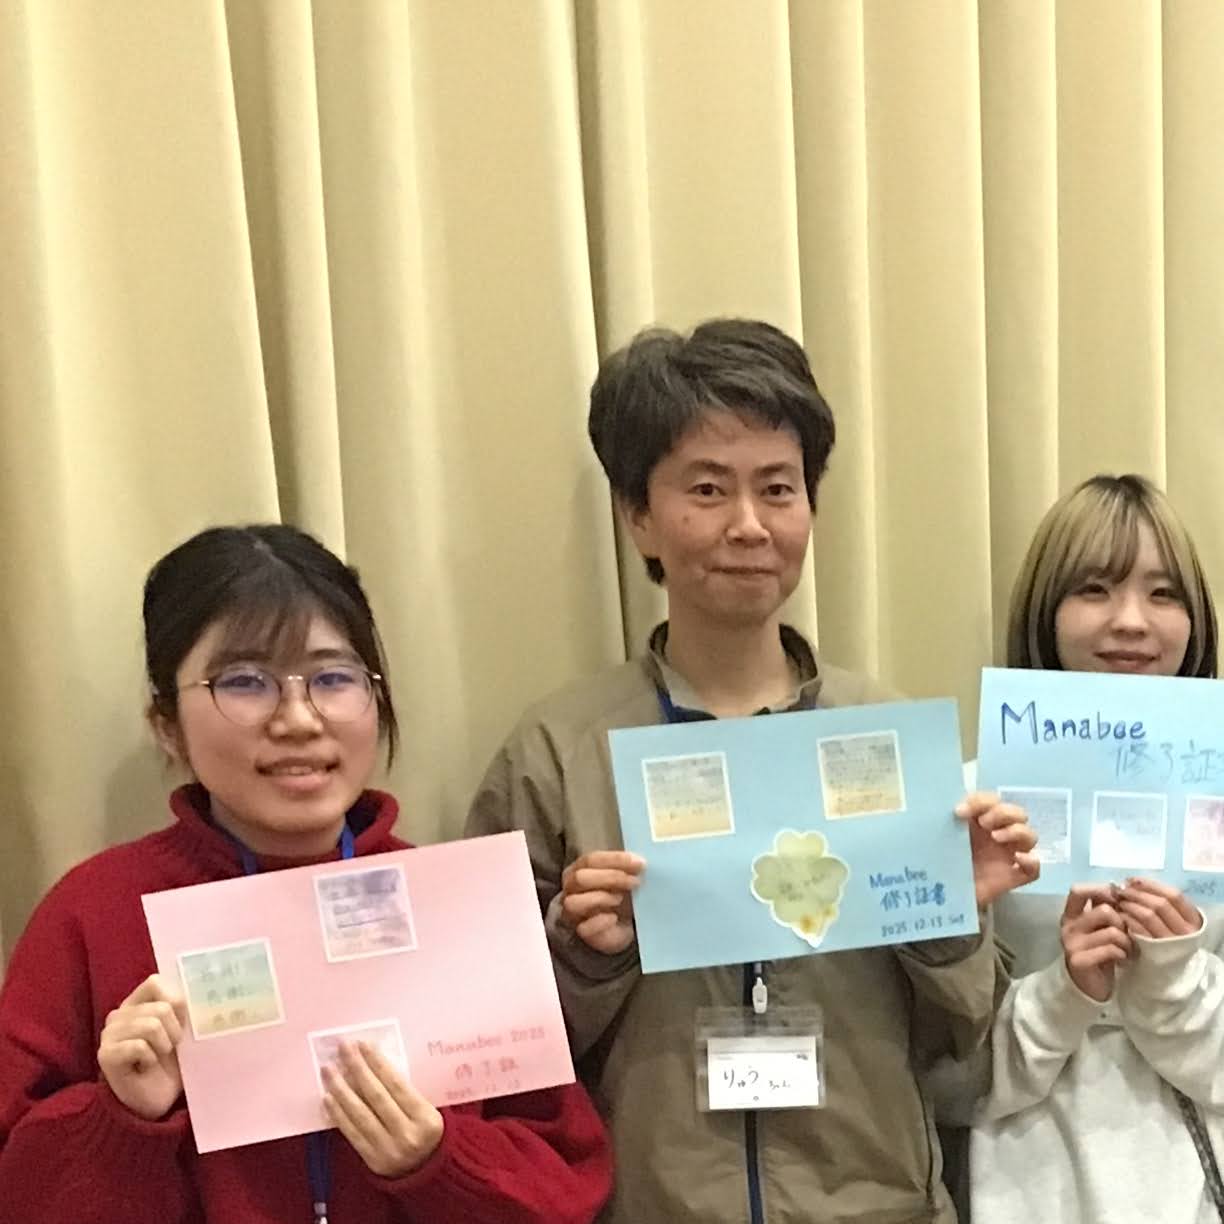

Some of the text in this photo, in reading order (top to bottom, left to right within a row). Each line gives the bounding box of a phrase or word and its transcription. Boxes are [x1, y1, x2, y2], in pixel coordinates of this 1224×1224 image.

[869, 866, 928, 889] Manabee
[880, 882, 946, 912] 修了証書
